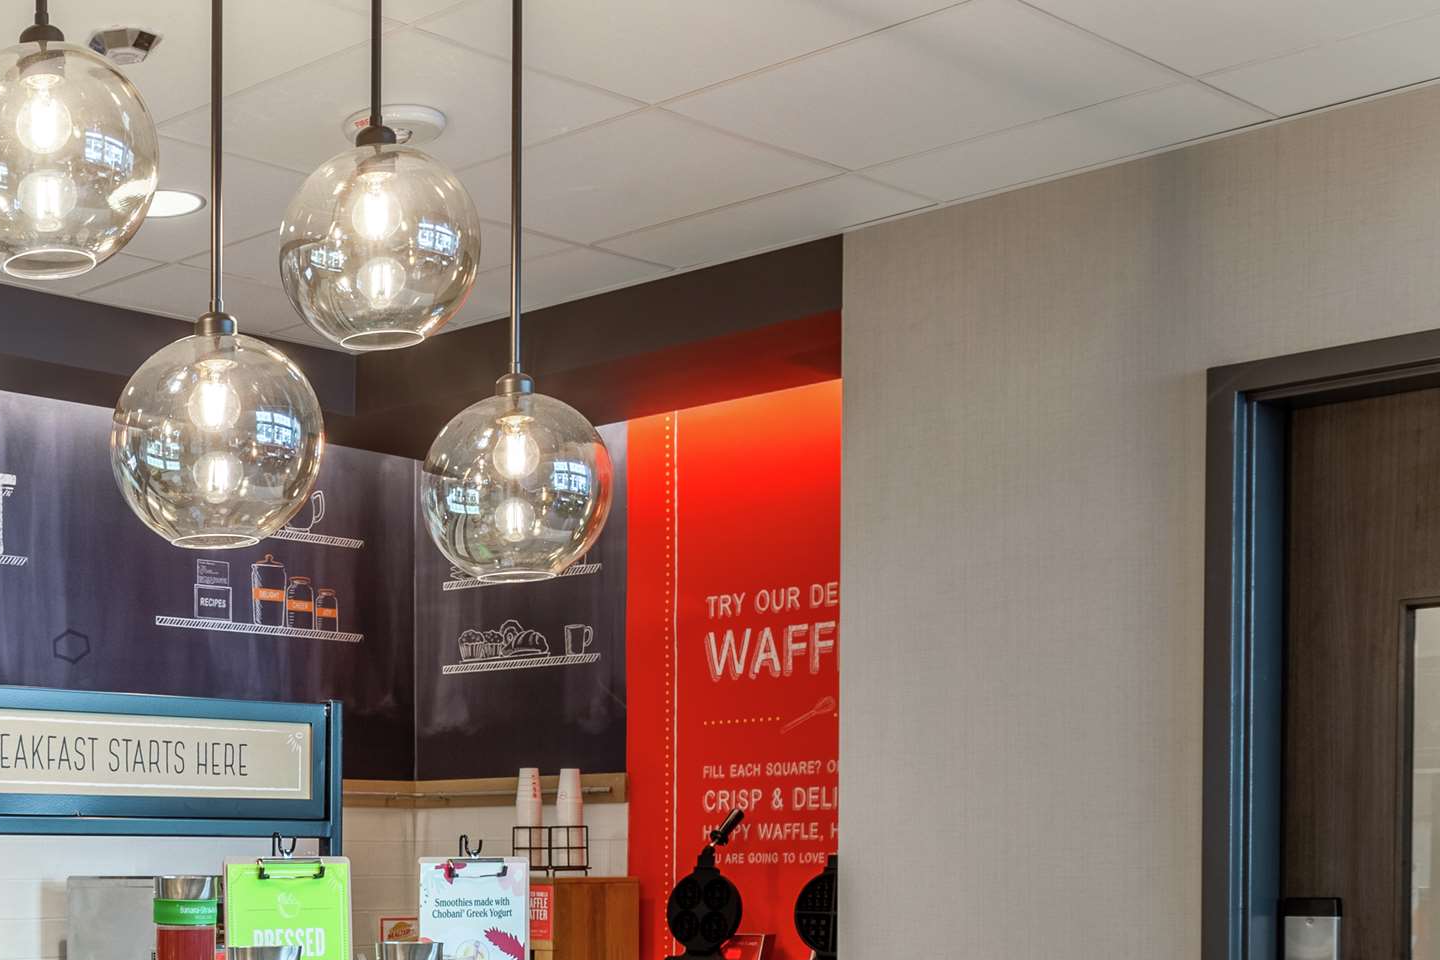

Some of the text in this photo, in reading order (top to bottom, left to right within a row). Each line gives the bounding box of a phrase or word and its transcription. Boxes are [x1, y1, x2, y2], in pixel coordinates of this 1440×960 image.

[200, 597, 226, 608] RECIPES
[705, 592, 746, 618] TRY
[755, 586, 800, 614] OUR
[704, 621, 839, 681] WAFF
[109, 738, 185, 774] STARTS
[197, 742, 248, 776] HERE
[703, 765, 725, 778] FILL
[730, 763, 761, 777] EACH
[766, 760, 821, 776] SQUARE?
[703, 789, 762, 811] CRISP
[772, 787, 783, 810] &
[758, 822, 824, 841] WAFFLE,
[725, 853, 744, 865] ARE
[748, 852, 778, 864] GOING
[783, 852, 795, 864] TO
[800, 852, 824, 864] LOVE
[435, 897, 510, 907] Smoothies made with
[466, 908, 488, 918] Greek
[489, 907, 513, 919] Yogurt
[253, 928, 326, 957] PRESSED
